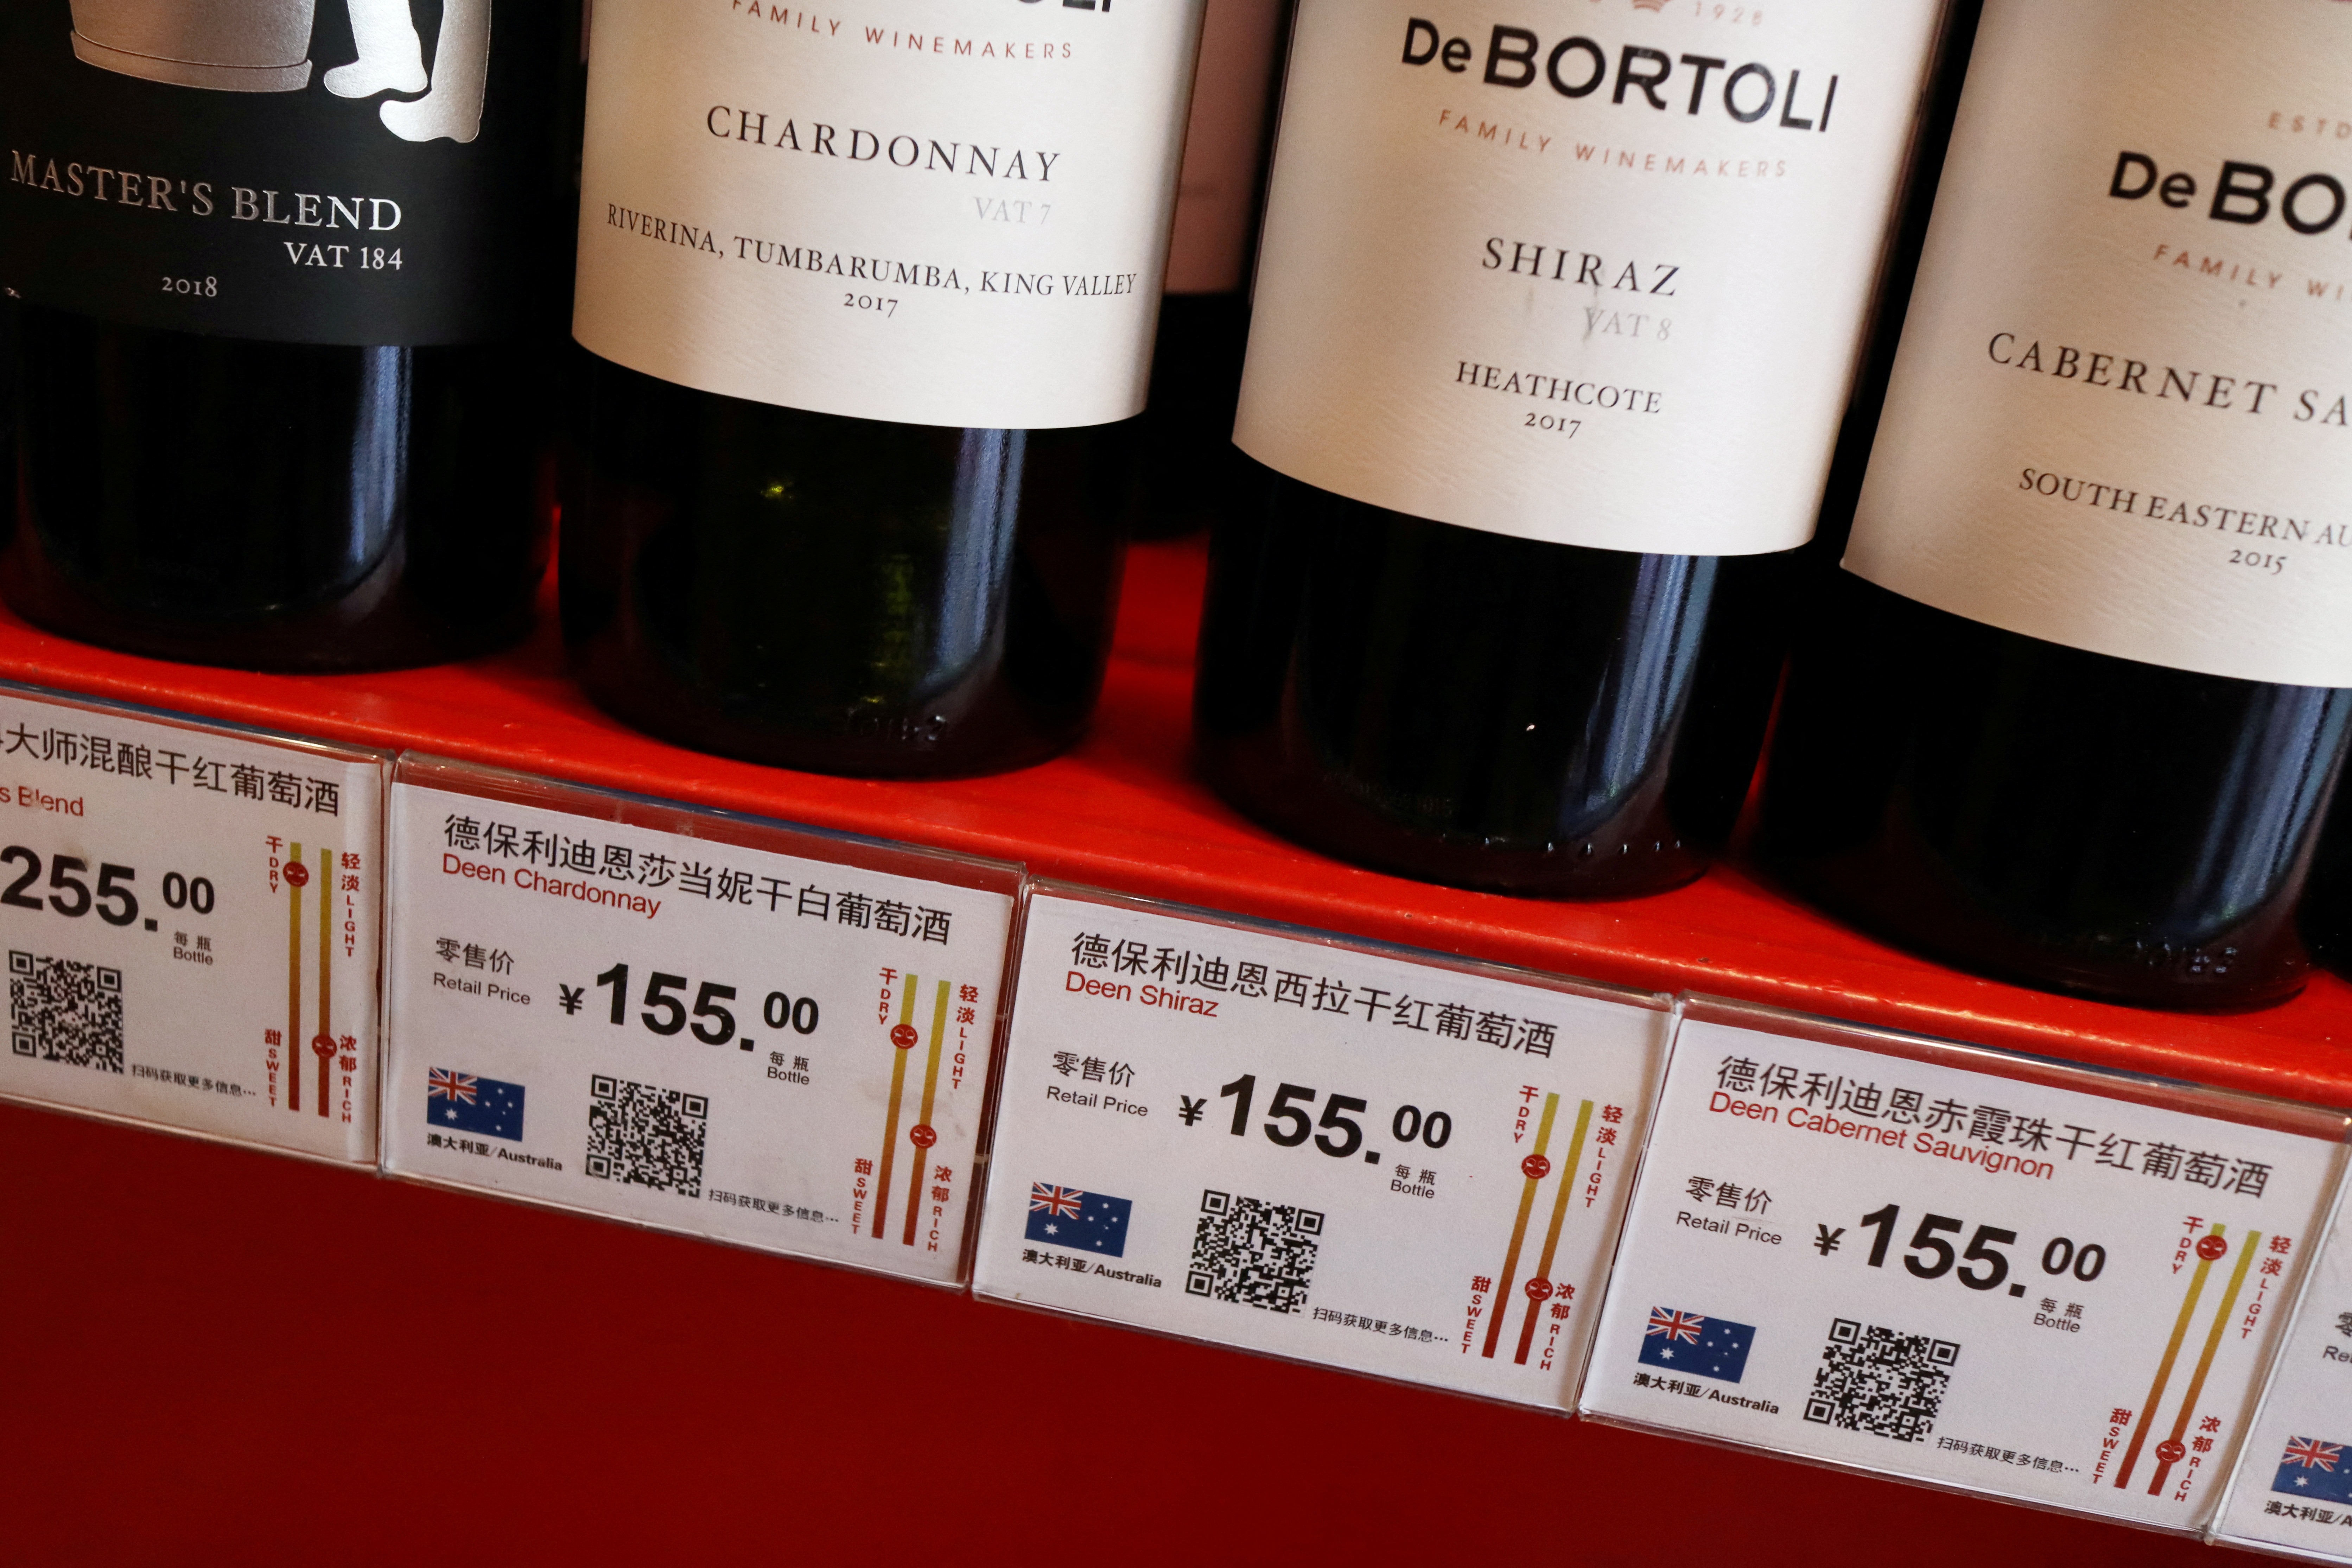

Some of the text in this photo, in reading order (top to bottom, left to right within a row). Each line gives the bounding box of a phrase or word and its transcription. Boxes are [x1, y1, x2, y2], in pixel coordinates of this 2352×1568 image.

[733, 0, 1072, 59] FAMILY WINEMAKERS
[1695, 2, 1762, 25] 1928
[1402, 17, 1839, 132] De BORTOLI
[707, 105, 1060, 182] CHARDONNAY
[1439, 110, 1787, 178] FAMILY WINEMAKERS
[11, 150, 401, 230] MASTER'S BLEND
[974, 197, 1051, 226] VAT 7
[2109, 151, 2352, 241] De BO
[284, 242, 402, 270] VAT 184
[608, 203, 1137, 296] RIVERINA, TUMBARUMBA, KING VALLEY
[1482, 237, 1680, 296] SHIRAZ
[2153, 244, 2352, 302] FAMILY WI
[162, 276, 217, 297] 2018
[844, 294, 898, 317] 2017
[1584, 307, 1672, 340] VAT 8
[1455, 361, 1662, 413] HEATHCOTE
[1988, 332, 2277, 415] CABERNET
[1525, 412, 1581, 438] 2017
[2019, 468, 2136, 514] SOUTH
[2145, 496, 2309, 542] EASTERN
[2228, 549, 2287, 575] 2015
[0, 723, 339, 817] 大师混酿干红葡萄酒
[18, 786, 83, 817] Blend
[265, 836, 283, 893] 干 DRY
[443, 853, 661, 919] Deen Chardonnay
[444, 814, 952, 945] 德保利迪恩莎当妮干白葡萄酒
[341, 852, 361, 957] 轻淡 LIGHT
[173, 946, 213, 965] Bottle
[436, 937, 515, 976] 零售价
[433, 972, 530, 1005] Retail Price
[879, 967, 898, 1025] 干 DRY
[1066, 971, 1219, 1017] Deen Shiraz
[1071, 932, 1558, 1058] 德保利迪恩西拉干红葡萄酒
[951, 984, 979, 1089] 轻淡 LIGHT
[265, 1029, 281, 1106] 甜 SWEET
[338, 1035, 357, 1123] 浓郁 RICH
[767, 1066, 810, 1085] Bottle
[1053, 1051, 1135, 1088] 零售价
[1047, 1086, 1148, 1117] Retail Price
[1514, 1085, 1539, 1143] 干 DRY
[1717, 1055, 2274, 1199] 德保利迪恩赤霞珠干红葡萄酒
[427, 1132, 562, 1172] 澳大利亚/Australia
[1585, 1105, 1623, 1208] 轻淡 LIGHT
[1709, 1091, 2054, 1180] Deen Cabernet Sauvignon
[852, 1158, 873, 1234] 甜 SWEET
[928, 1166, 952, 1252] 浓郁 RICH
[1390, 1179, 1435, 1199] Bottle
[1685, 1176, 1772, 1215] 零售价
[1676, 1211, 1782, 1246] Retail Price
[2171, 1217, 2204, 1275] 干 DRY
[1022, 1249, 1162, 1288] 澳大利亚/Australia
[2240, 1235, 2292, 1339] 轻淡 LIGHT
[1461, 1276, 1492, 1354] 甜 SWEET
[1540, 1283, 1576, 1371] 浓郁 RICH
[2033, 1313, 2081, 1333] Bottle
[2322, 1345, 2352, 1364] Re
[1633, 1371, 1779, 1414] 澳大利亚/Australia
[2092, 1408, 2133, 1484] 甜 SWEET
[2174, 1416, 2222, 1502] 浓郁 RICH
